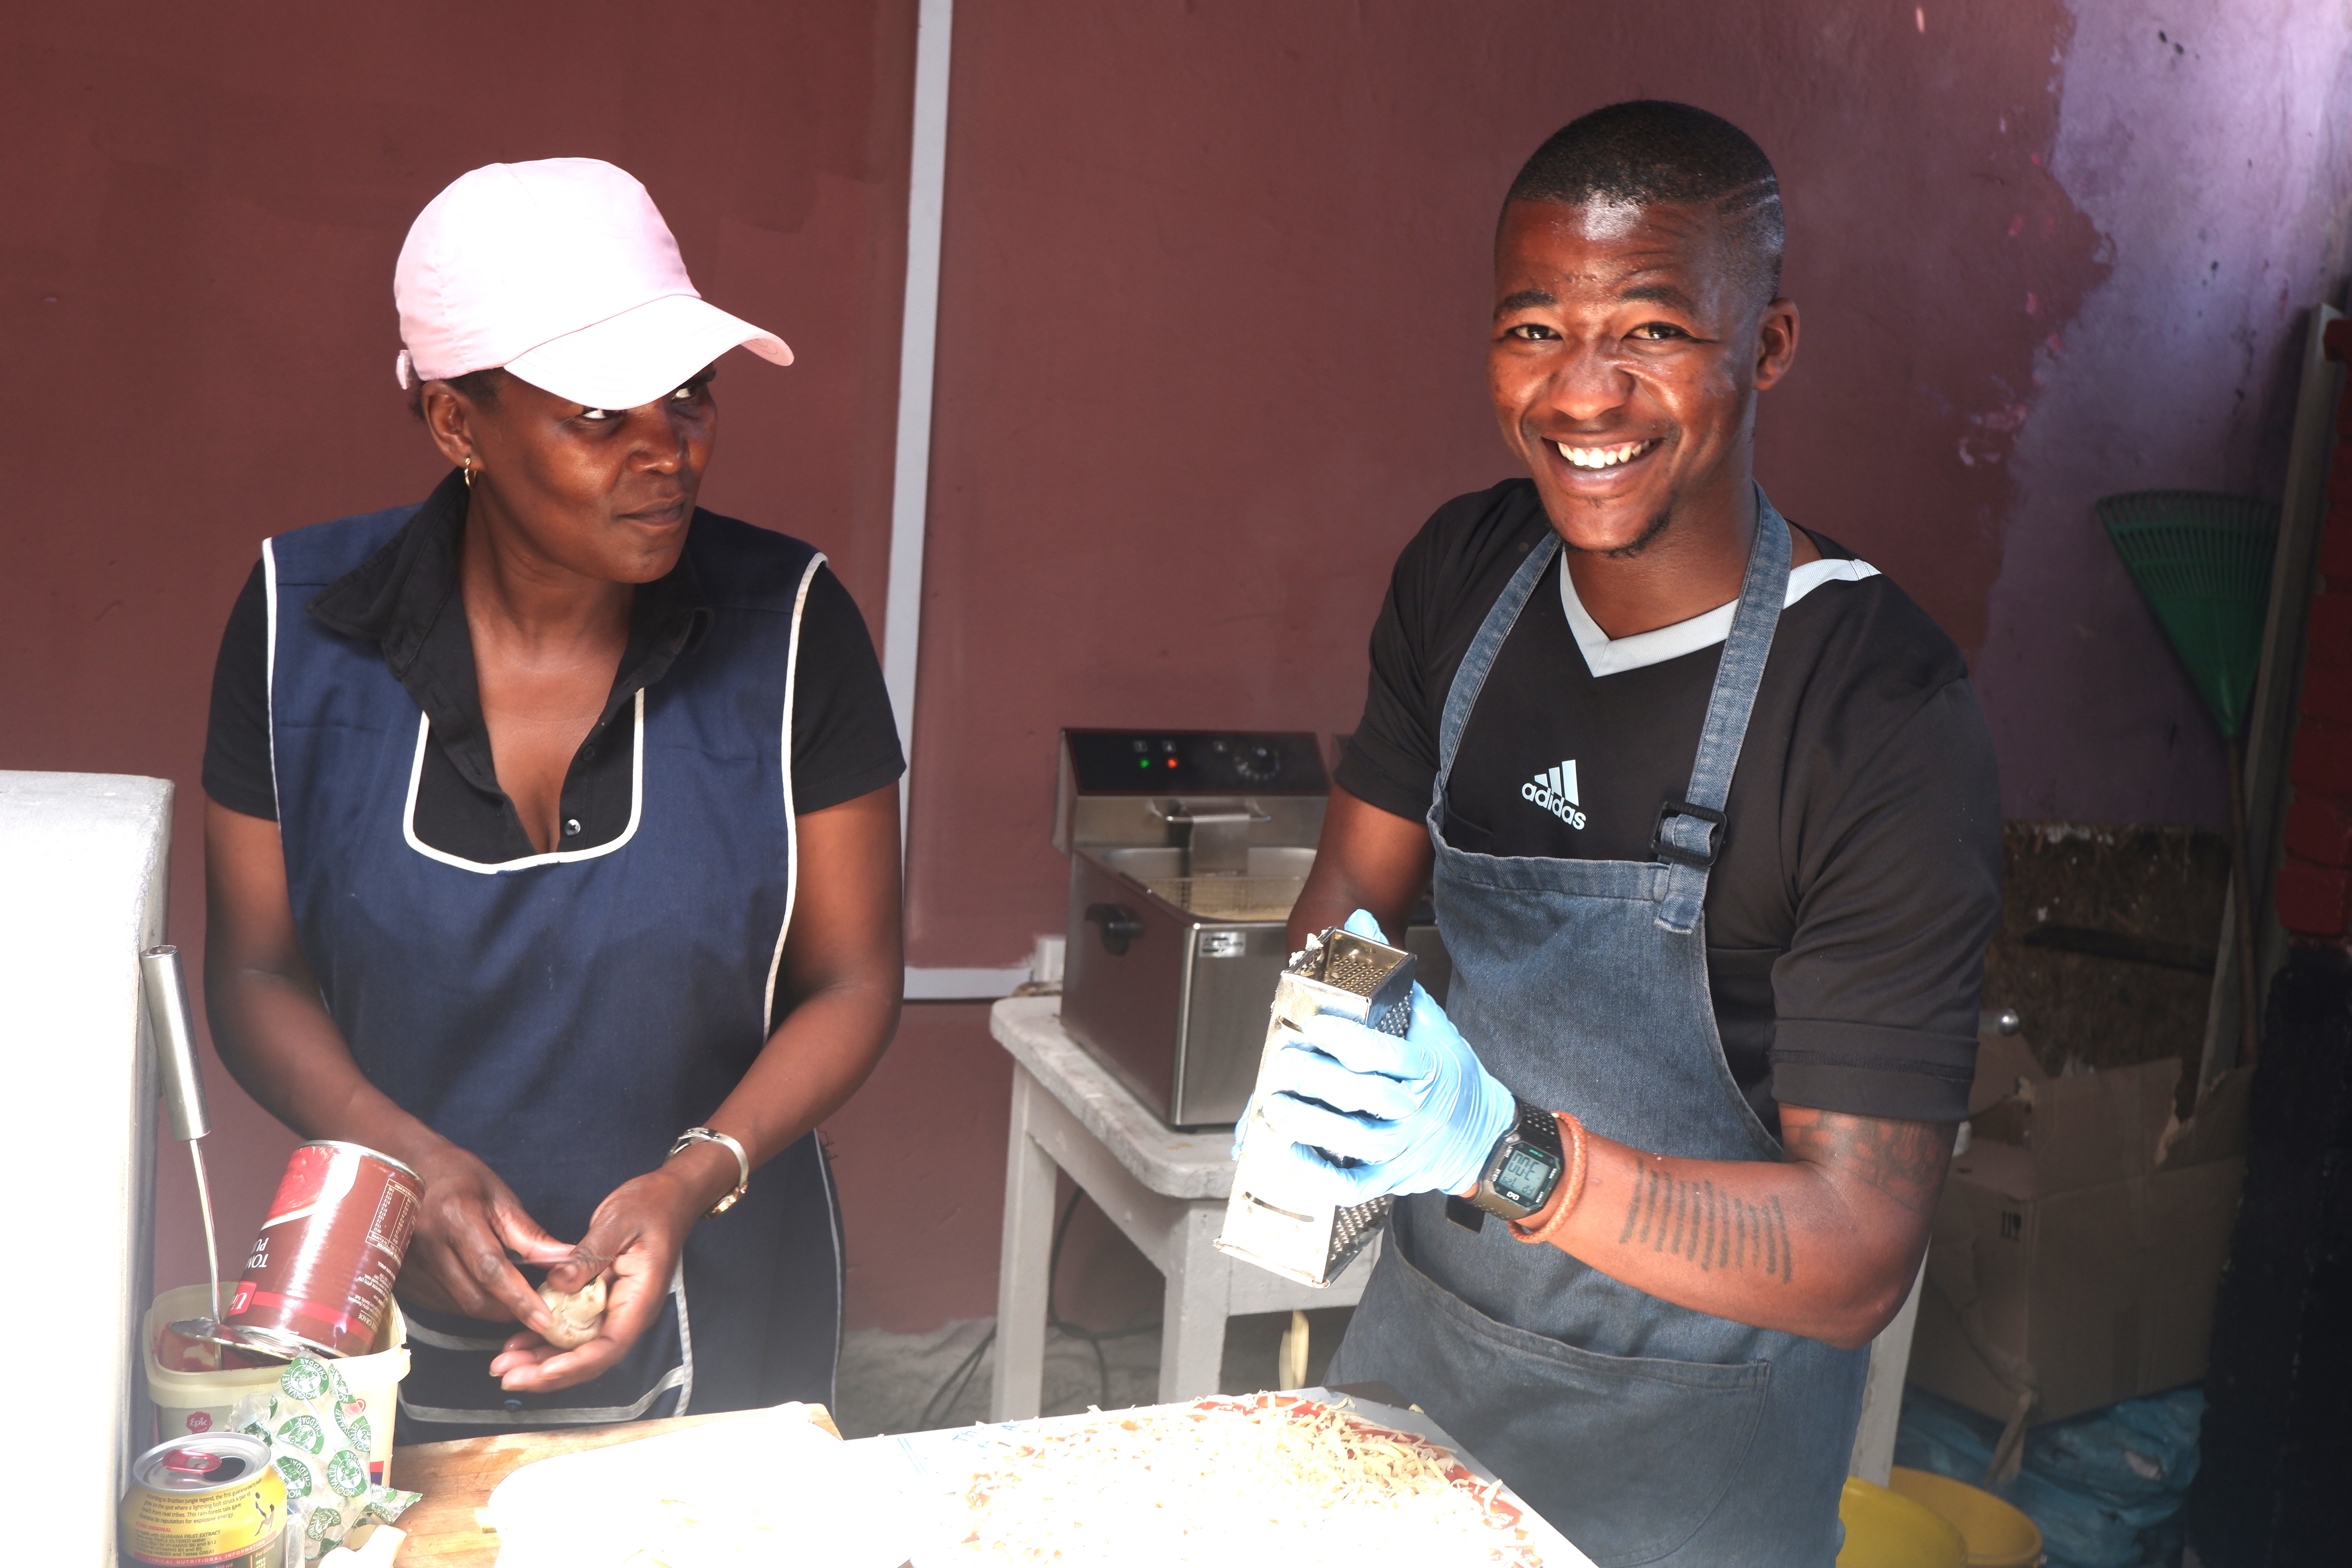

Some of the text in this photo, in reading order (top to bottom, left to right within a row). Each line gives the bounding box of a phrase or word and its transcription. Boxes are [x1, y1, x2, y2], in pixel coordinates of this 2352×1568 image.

[1521, 782, 1586, 830] adidas
[299, 1357, 328, 1380] CHEDDAR
[190, 1417, 208, 1427] Epic
[298, 1416, 323, 1437] CHEDDAR
[293, 1459, 311, 1487] CHEDDA
[147, 1493, 162, 1503] According
[232, 1482, 256, 1497] guarana-berry
[193, 1502, 212, 1511] lightning
[222, 1497, 236, 1506] struck
[198, 1507, 222, 1517] rain-forest
[232, 1503, 242, 1511] gave
[139, 1512, 154, 1521] Guarana
[176, 1555, 223, 1565] NUTRITIONAL
[225, 1539, 265, 1559] INFORMATION
